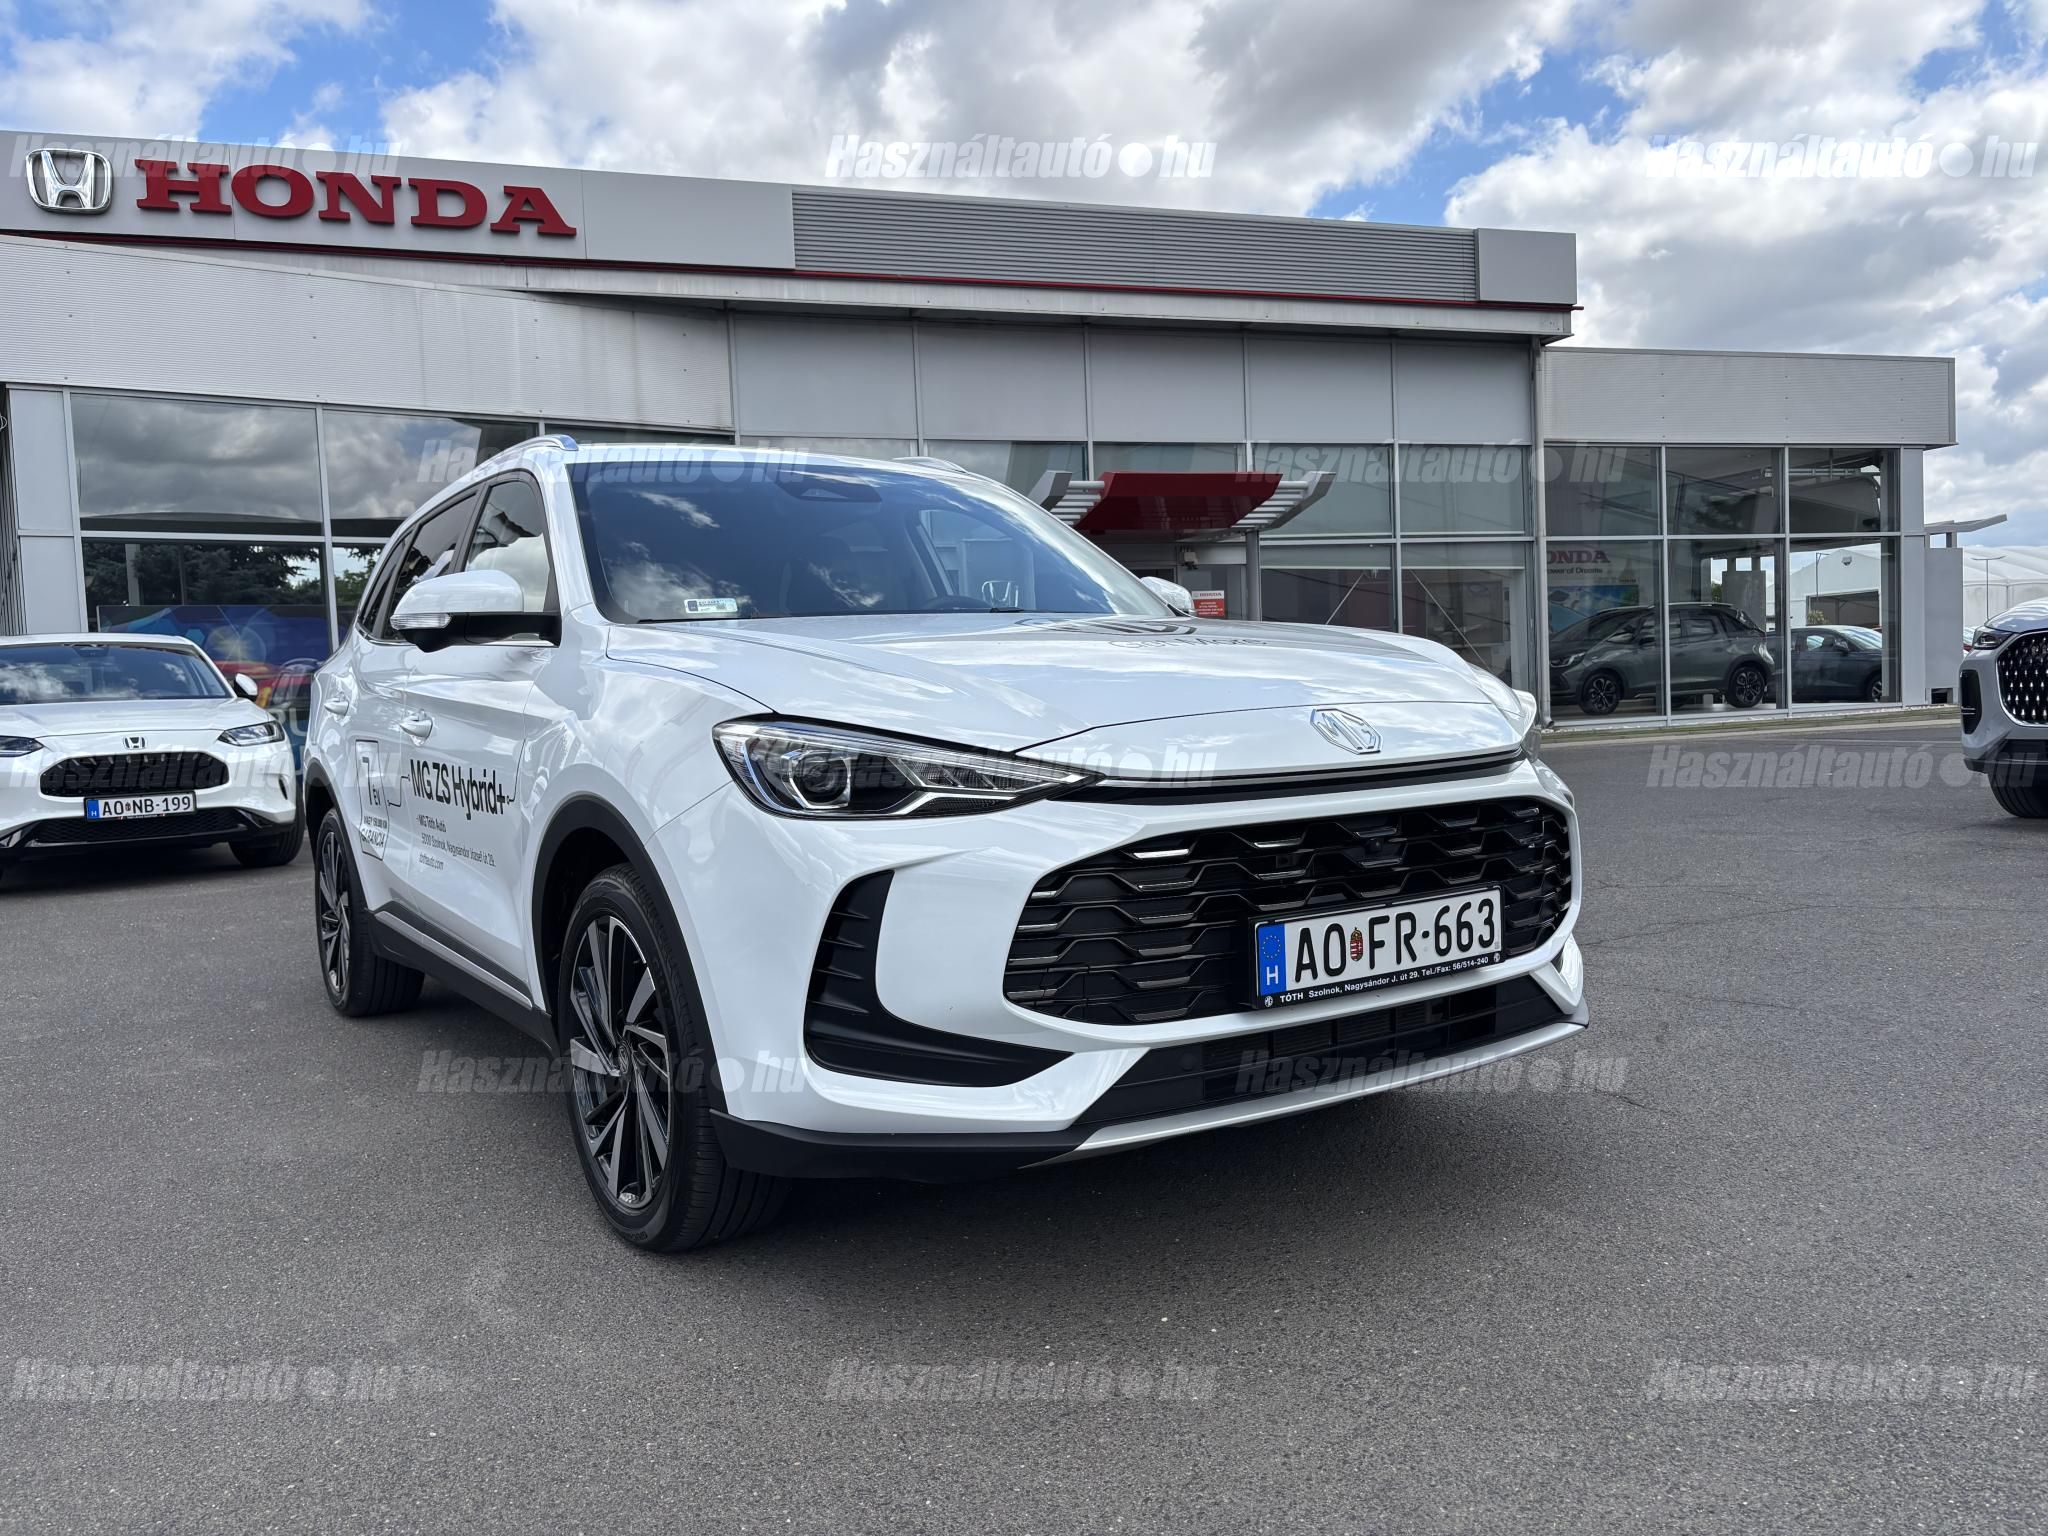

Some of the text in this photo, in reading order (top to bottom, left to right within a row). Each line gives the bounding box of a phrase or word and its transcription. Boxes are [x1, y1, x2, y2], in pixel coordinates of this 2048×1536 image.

[135, 158, 577, 237] HONDA
[1547, 550, 1611, 564] ONDA
[362, 757, 372, 805] 7
[410, 759, 505, 820] MG ZS Hybrid+
[102, 800, 125, 816] AO
[133, 796, 191, 814] NB-199
[1266, 965, 1279, 986] H
[1295, 922, 1347, 982] AO
[1280, 992, 1304, 1003] TÓTH
[1308, 986, 1343, 998] Szolnok,
[1344, 978, 1390, 992] Nagysándor
[1391, 975, 1398, 983] J.
[1400, 972, 1408, 981] út
[1409, 971, 1420, 979] 29.
[1421, 964, 1451, 976] Tel./Fax:
[1452, 956, 1489, 971] 56/514-240
